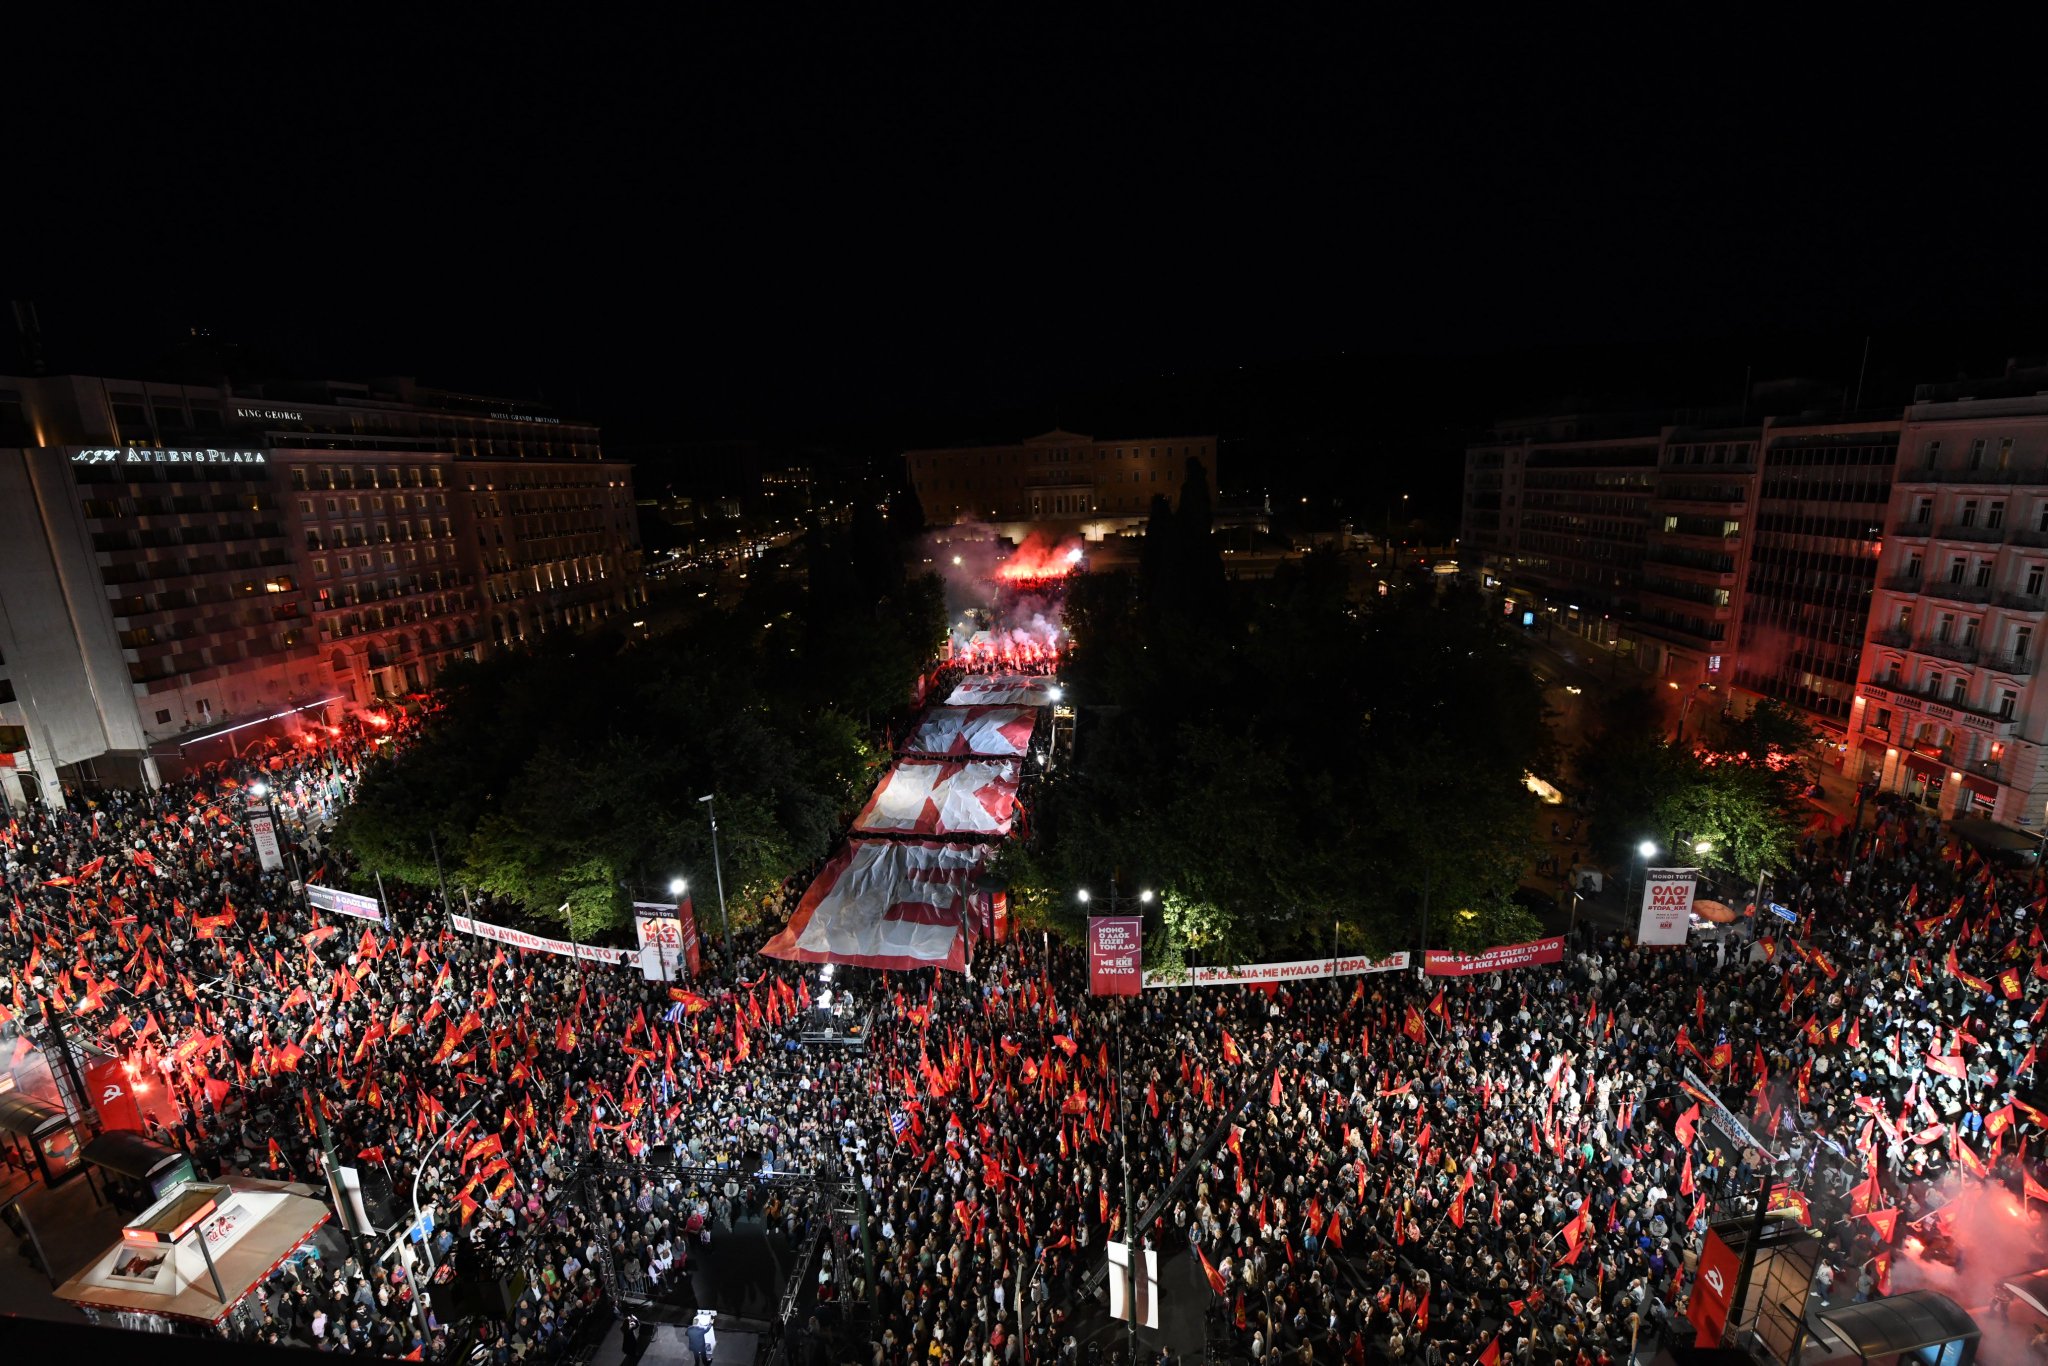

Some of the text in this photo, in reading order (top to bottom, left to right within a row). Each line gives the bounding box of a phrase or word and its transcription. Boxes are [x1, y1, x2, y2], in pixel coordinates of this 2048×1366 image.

[237, 408, 303, 421] KING GEORGE
[126, 447, 205, 462] ATHENS
[206, 449, 266, 463] PLAZA
[1652, 885, 1689, 896] ΟΛΟΙ
[1653, 895, 1687, 905] ΜΑΣ
[456, 918, 477, 933] ΚΚ
[479, 924, 495, 937] ΠΙΟ
[499, 929, 540, 947] ΔΥΝΑΤΟ
[547, 941, 574, 955] ΝΙΚΗ
[595, 948, 612, 960] ΤΟ
[1500, 948, 1526, 958] ΣΩΖΕΙ
[1527, 945, 1539, 953] ΤΟ
[1540, 942, 1559, 951] ΛΑΟ
[1116, 958, 1132, 967] ΚΚΕ
[1461, 953, 1533, 970] ΜΕ ΚΚΕ ΔΥΝΑΤΟ!
[1200, 972, 1215, 981] ΜΕ
[1262, 968, 1279, 978] ΜΕ
[1281, 964, 1320, 977] ΜΥΑΛΟ
